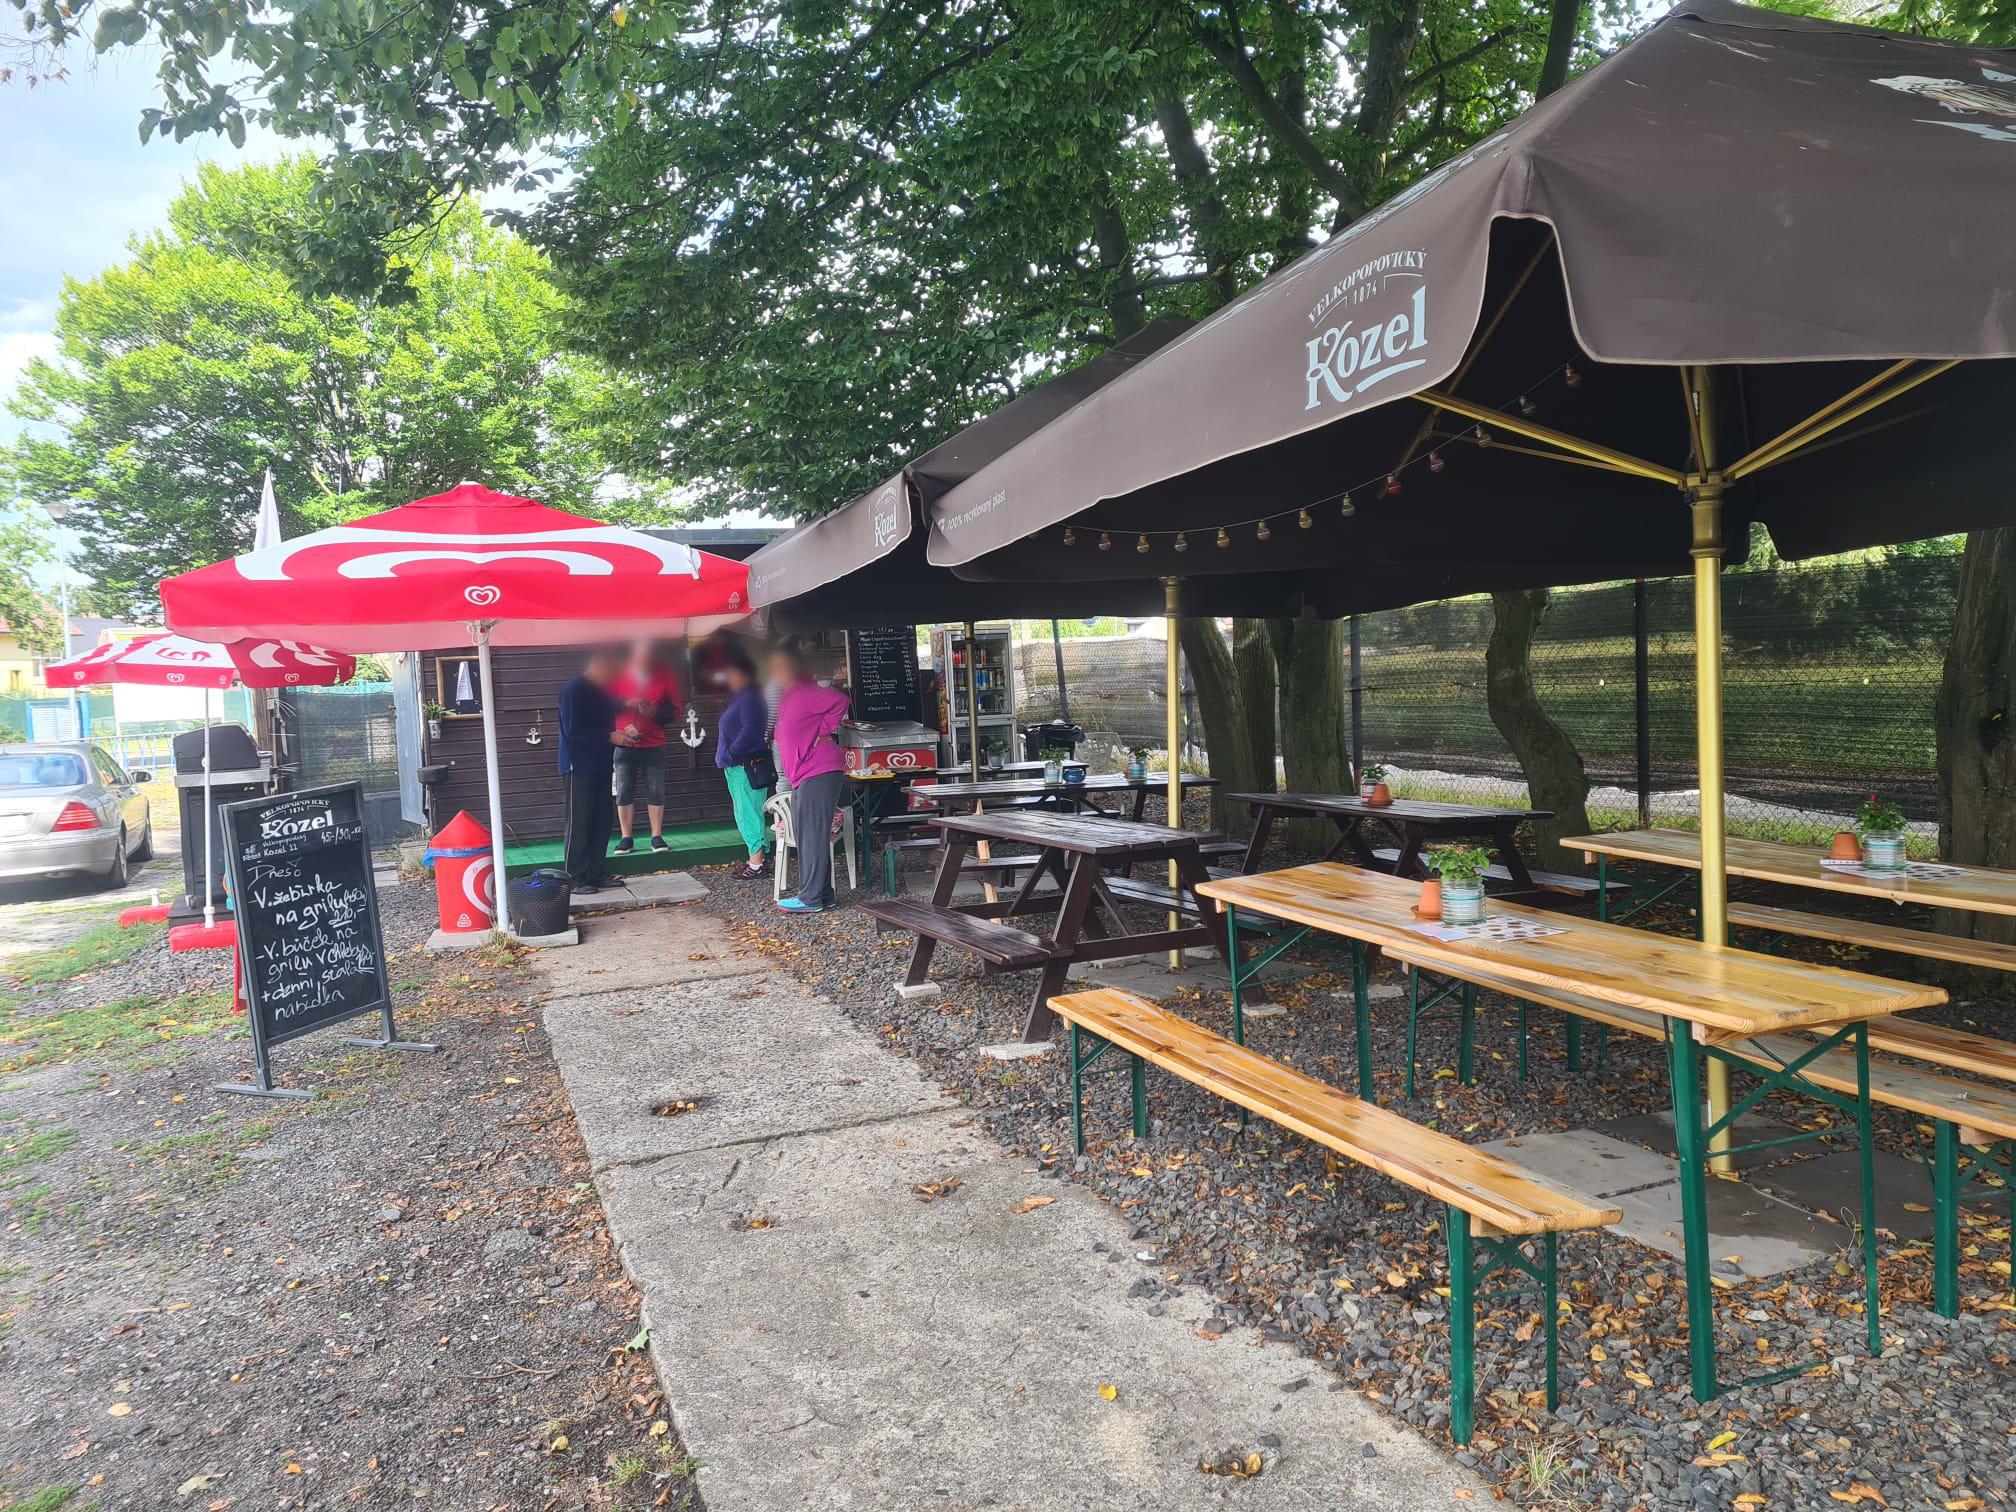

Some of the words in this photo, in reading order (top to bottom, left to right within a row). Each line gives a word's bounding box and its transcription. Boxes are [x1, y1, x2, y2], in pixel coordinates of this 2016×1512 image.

[1308, 246, 1427, 323] VELKOPOPOVICKÝ
[1353, 280, 1377, 305] 1874
[1305, 285, 1428, 410] Kozel
[947, 514, 964, 532] 100%
[963, 496, 993, 525] recyklovaný
[992, 488, 1007, 511] plast
[874, 504, 897, 547] Kozel
[260, 810, 335, 839] Kozel
[289, 806, 305, 815] 1874
[264, 846, 287, 857] Kozel
[289, 843, 298, 852] 11
[276, 910, 298, 925] na
[298, 894, 347, 930] grilu
[336, 926, 358, 940] na
[267, 956, 313, 984] grilu
[322, 960, 363, 984] stálá
[275, 984, 345, 1021] nabídka
